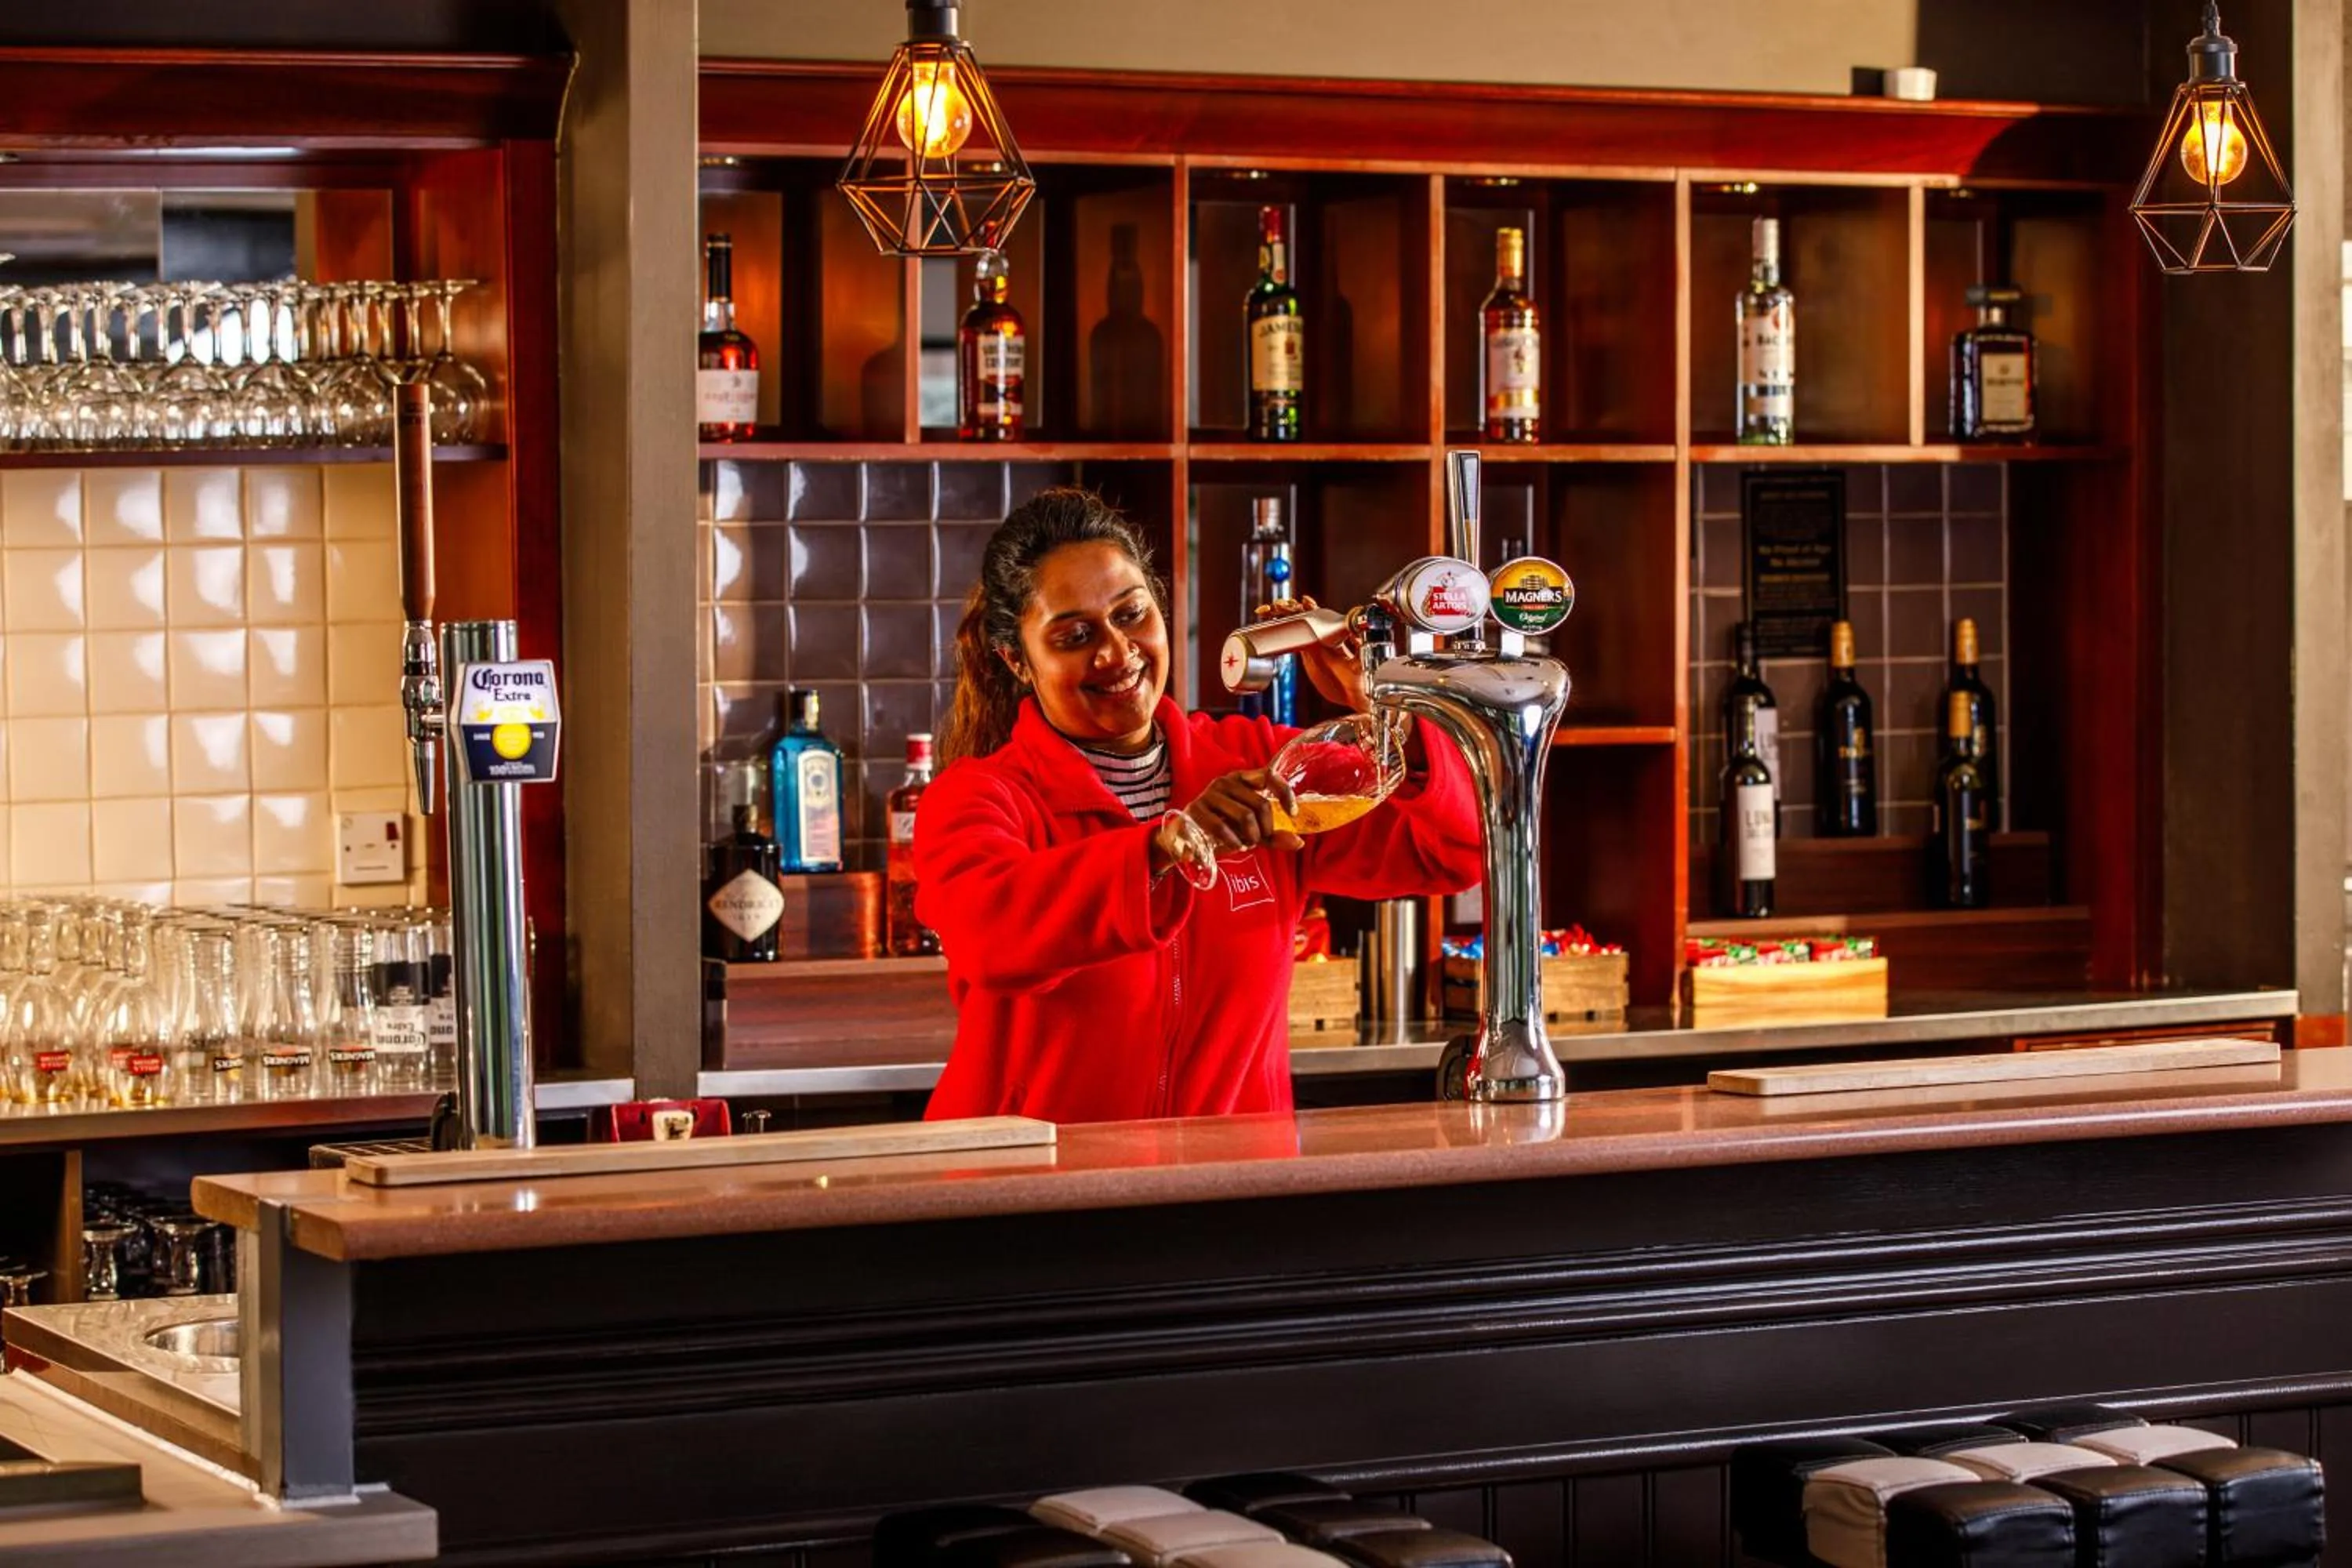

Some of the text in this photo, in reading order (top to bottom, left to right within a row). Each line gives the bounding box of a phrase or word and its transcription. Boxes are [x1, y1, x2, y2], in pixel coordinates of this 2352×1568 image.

[1433, 592, 1466, 601] STELLA
[1504, 590, 1563, 603] MAGNERS
[471, 668, 545, 692] Corona
[494, 688, 532, 701] Extra
[1229, 873, 1260, 893] ibis
